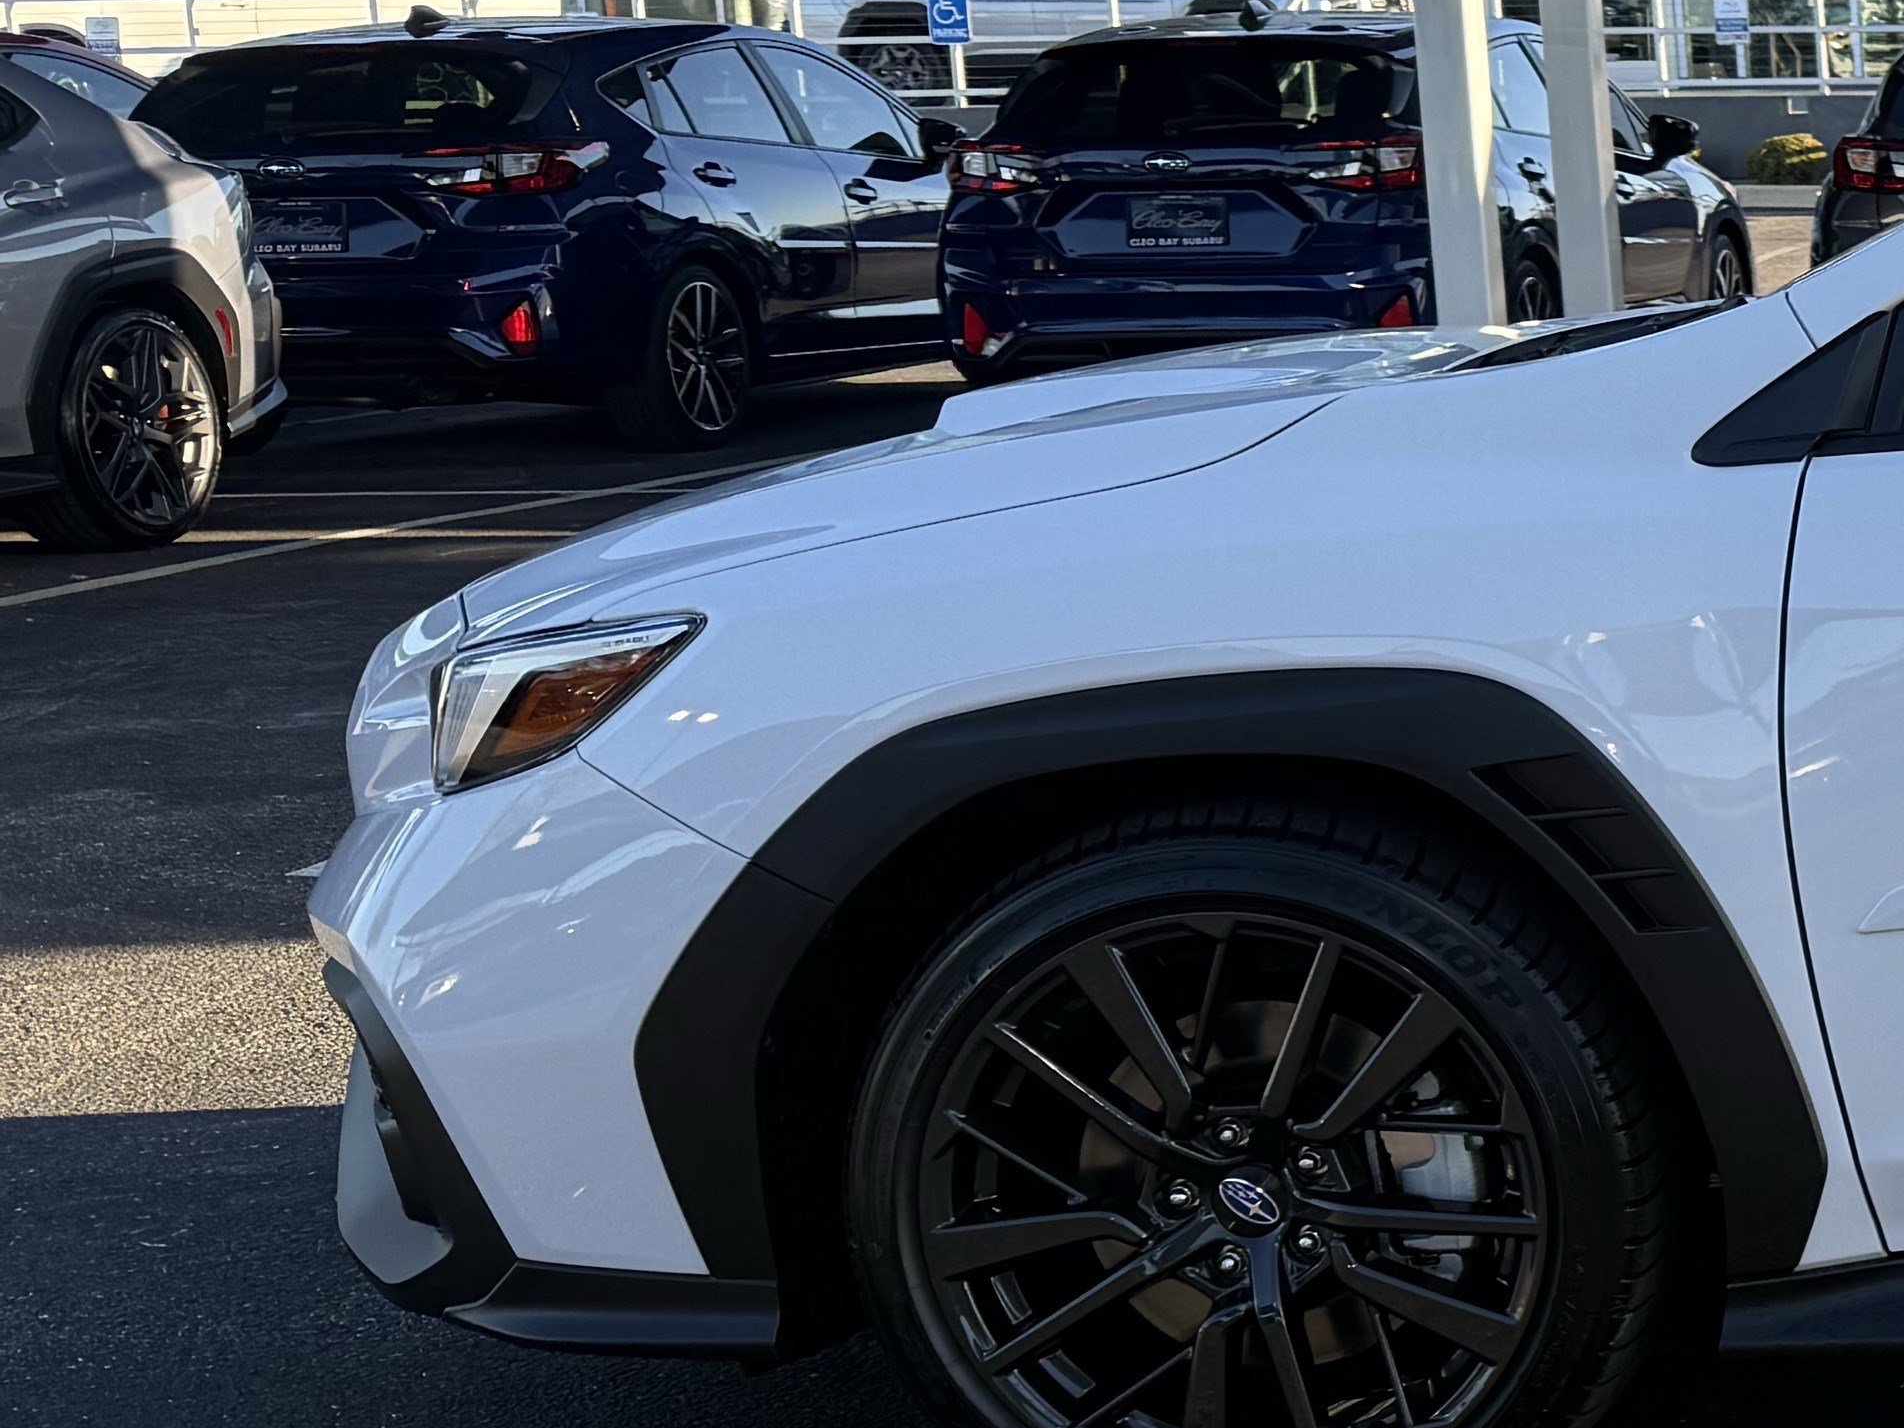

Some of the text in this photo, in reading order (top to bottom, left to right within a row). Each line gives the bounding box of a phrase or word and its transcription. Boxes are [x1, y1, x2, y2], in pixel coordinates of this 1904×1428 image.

[1129, 236, 1225, 247] CLEO BAY SUBARU
[252, 243, 342, 253] LEO BAY SUBARU
